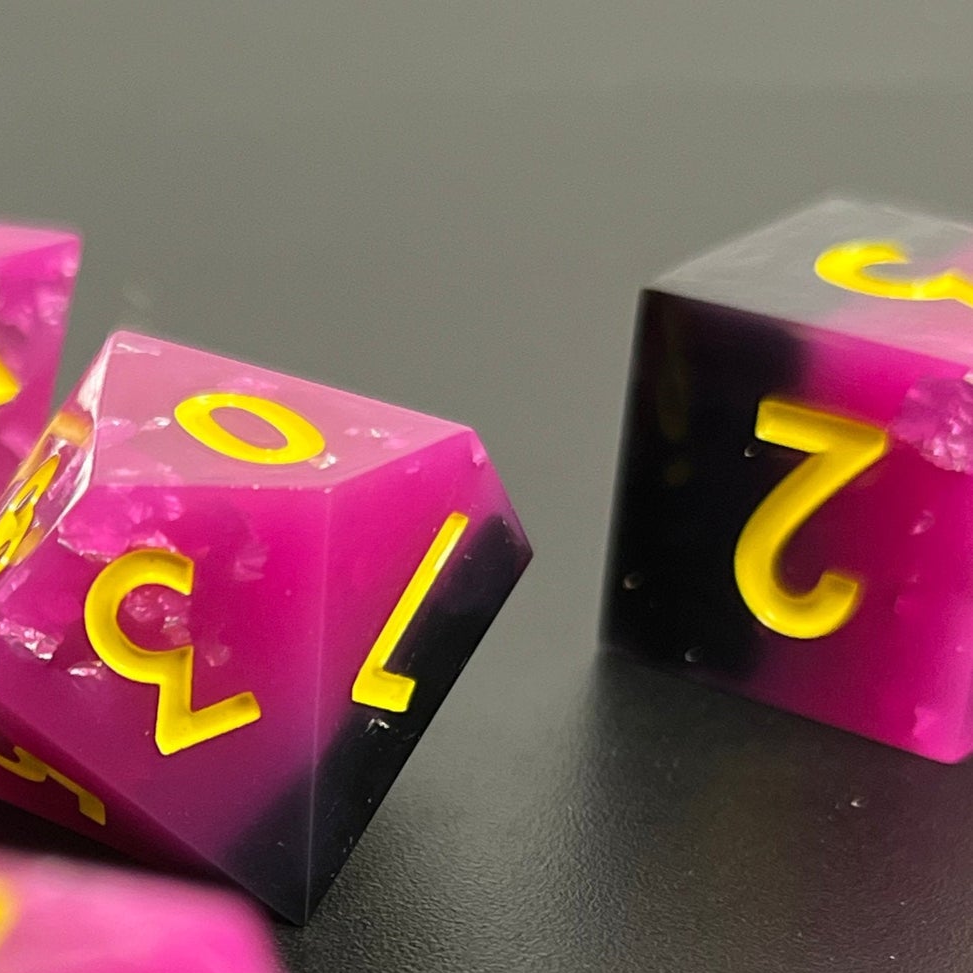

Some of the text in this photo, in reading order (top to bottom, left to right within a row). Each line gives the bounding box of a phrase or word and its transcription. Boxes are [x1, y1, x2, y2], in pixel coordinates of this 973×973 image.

[174, 392, 326, 466] 0
[733, 397, 888, 640] 2
[84, 548, 262, 756] 3
[351, 511, 469, 713] 1
